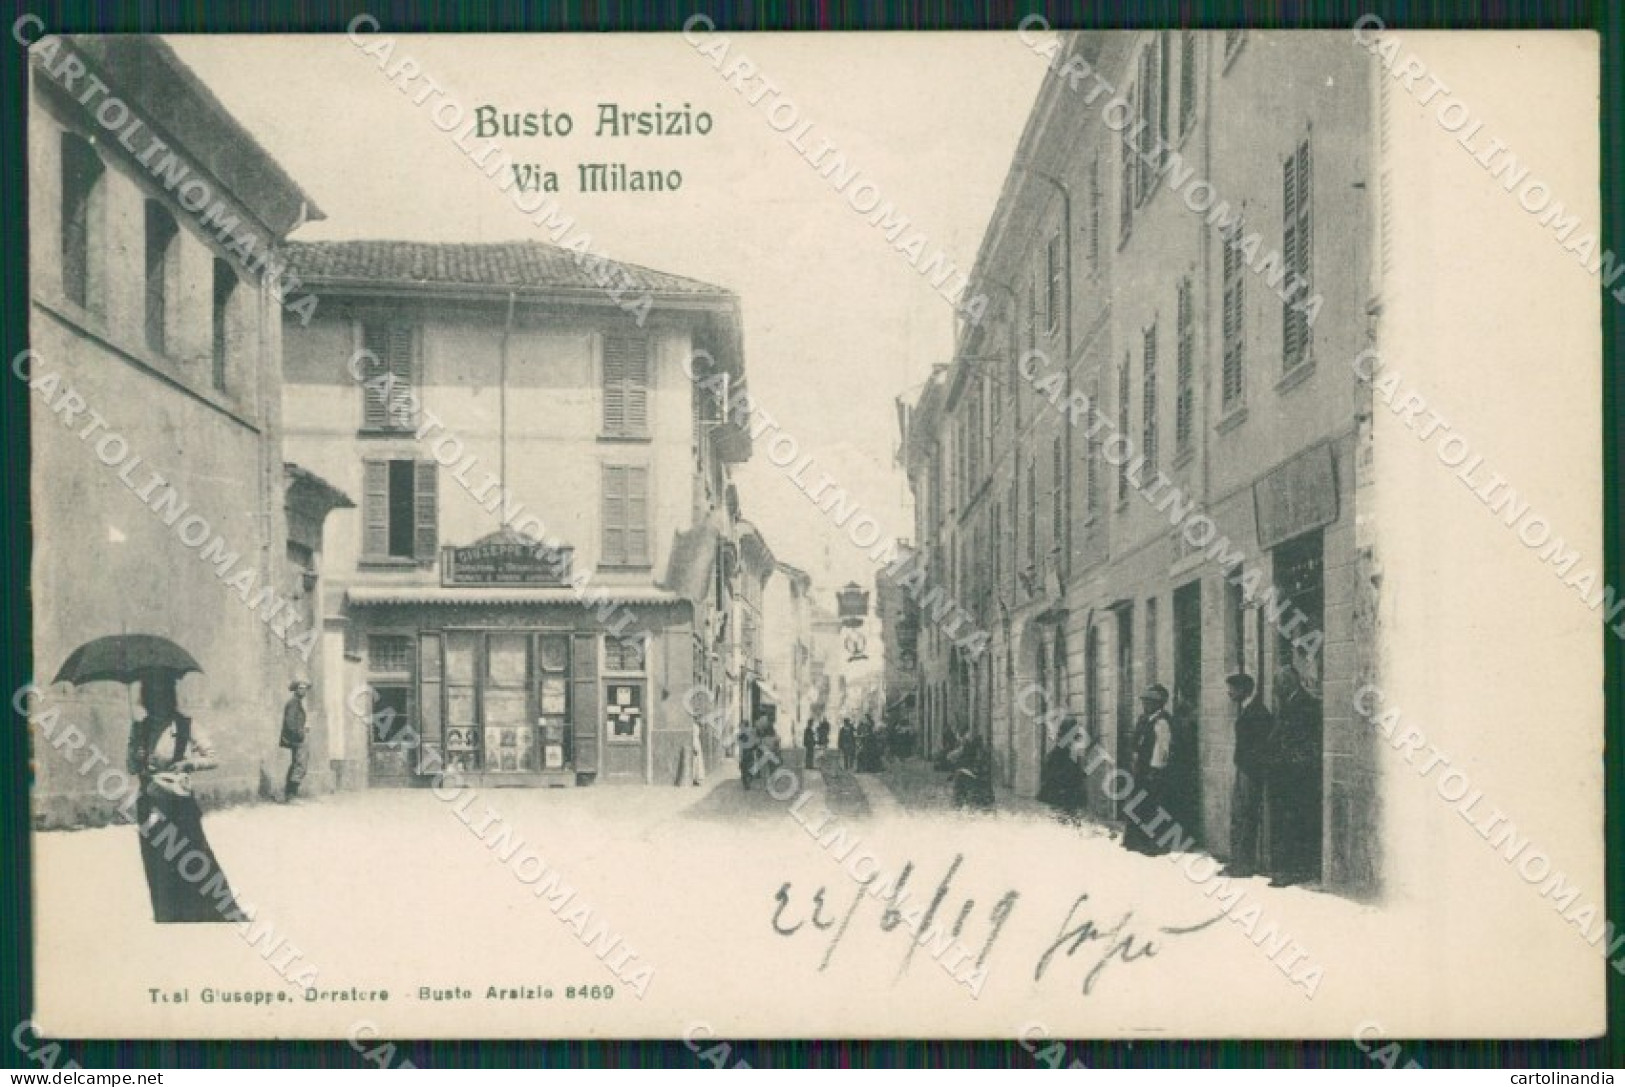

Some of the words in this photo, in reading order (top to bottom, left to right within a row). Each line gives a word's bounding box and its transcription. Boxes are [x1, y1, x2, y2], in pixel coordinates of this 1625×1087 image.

[475, 104, 573, 138] Busto
[595, 102, 713, 137] Arsizio
[512, 163, 559, 193] Via
[578, 163, 683, 193] Milano
[419, 986, 472, 1001] Busto
[486, 986, 553, 1000] Arsizio
[566, 984, 614, 999] 8469
